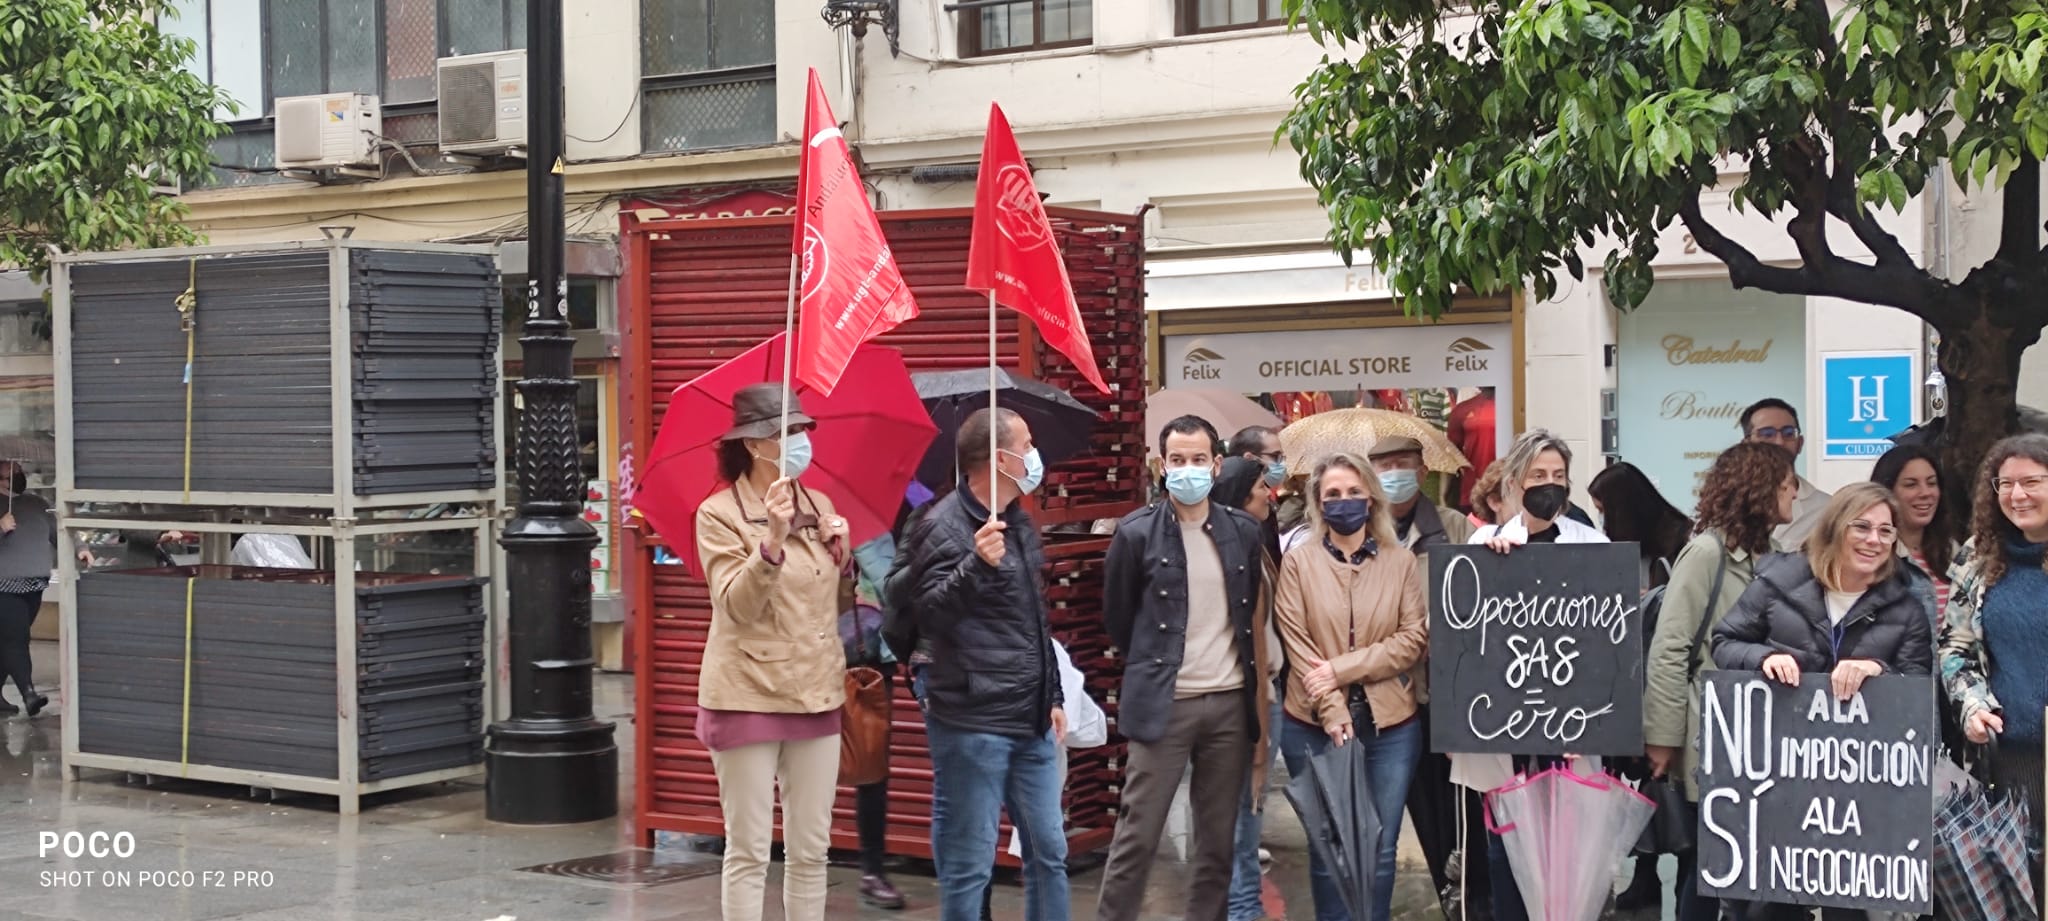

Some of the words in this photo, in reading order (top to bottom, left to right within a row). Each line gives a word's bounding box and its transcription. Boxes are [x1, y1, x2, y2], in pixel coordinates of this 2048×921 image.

[1344, 272, 1384, 293] Feli
[1182, 365, 1221, 380] Felix
[1258, 359, 1344, 378] OFFICIAL
[1349, 356, 1412, 376] STORE
[1445, 354, 1489, 372] Felix
[1659, 333, 1774, 366] Catedral
[1660, 390, 1747, 429] Boutiq
[1442, 554, 1638, 655] Oposiciones
[1505, 634, 1580, 688] SAS
[1704, 679, 1774, 780] NO
[1780, 728, 1929, 787] IMPOSICIÓN
[1701, 779, 1775, 891] SÍ
[1770, 838, 1929, 903] NEGOCIACIÓN
